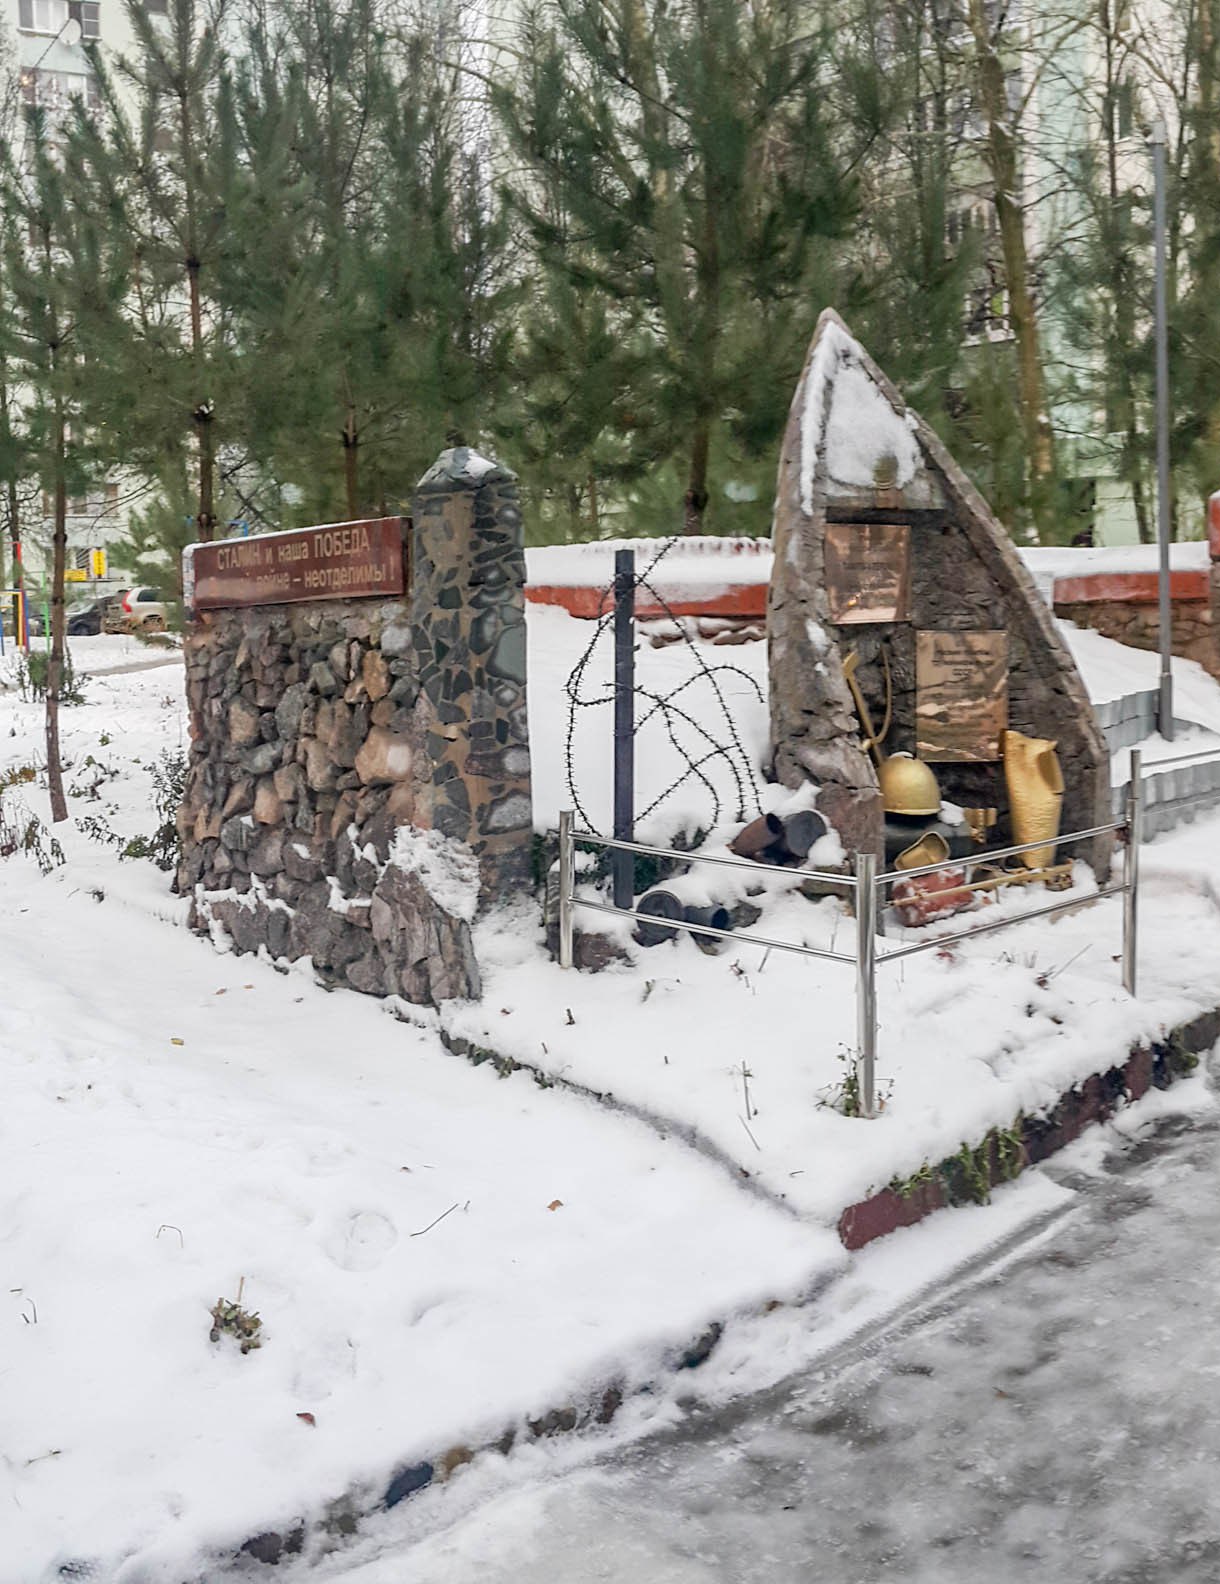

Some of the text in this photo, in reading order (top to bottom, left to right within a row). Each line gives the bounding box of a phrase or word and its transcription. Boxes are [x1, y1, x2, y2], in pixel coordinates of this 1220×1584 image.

[217, 527, 370, 570] СТАЛИН и наша ПОБЕДА
[304, 564, 387, 591] неотделимы
